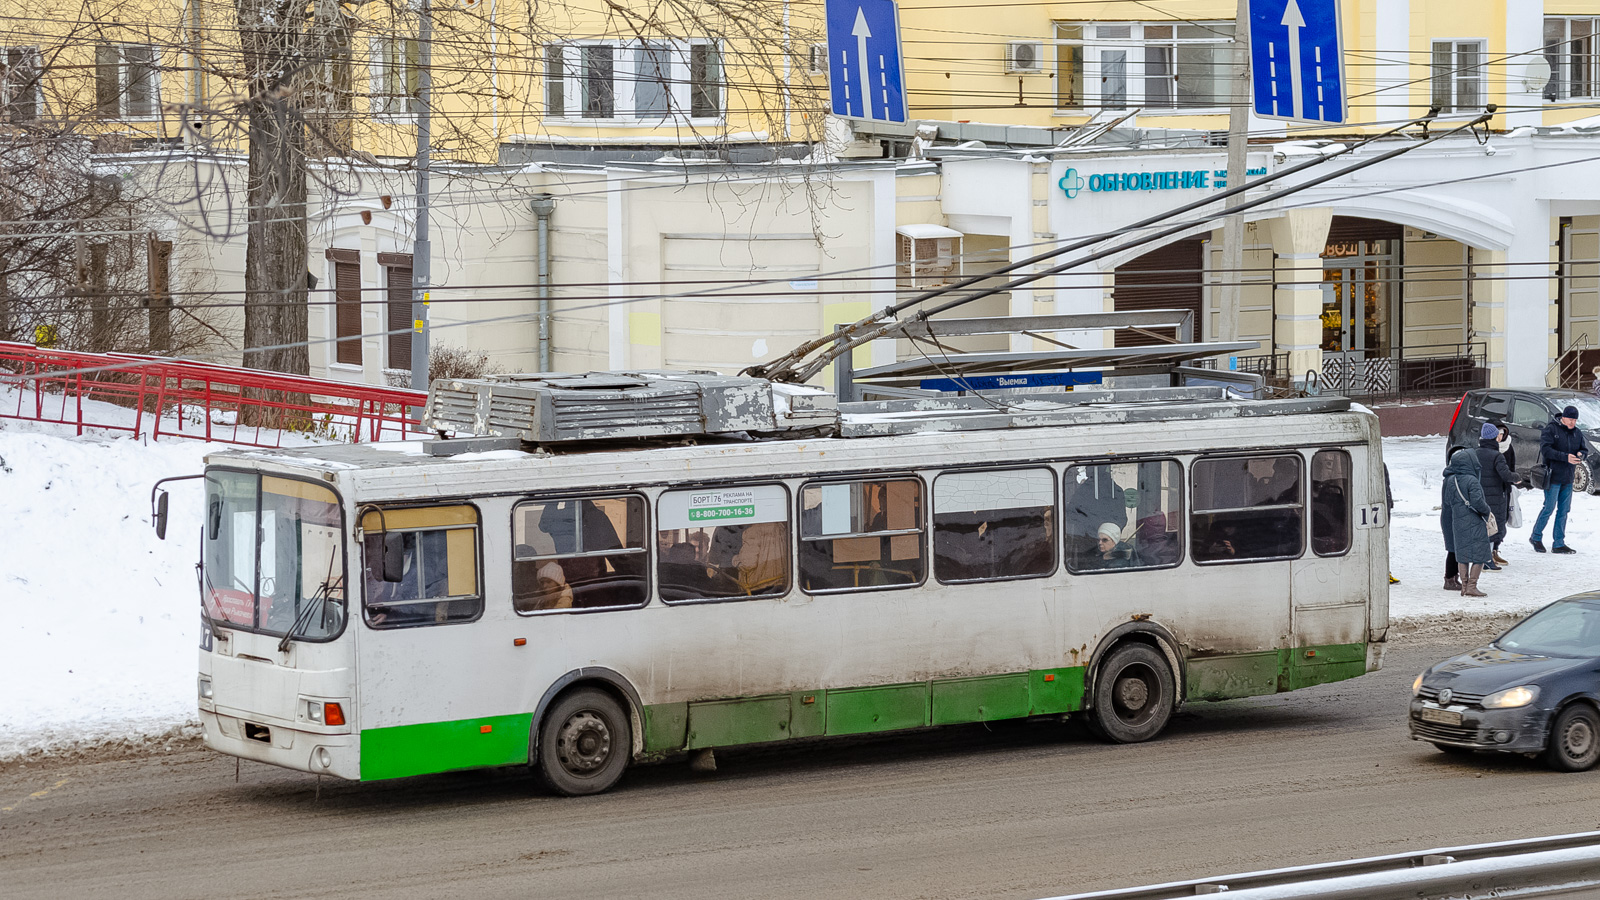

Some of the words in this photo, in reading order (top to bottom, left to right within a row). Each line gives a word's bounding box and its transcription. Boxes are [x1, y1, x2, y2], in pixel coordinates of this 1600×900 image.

[1089, 171, 1209, 192] ОБНОВЛЕНИЕ
[998, 377, 1028, 386] Выемка
[693, 496, 710, 504] БОРТ
[713, 495, 722, 503] 76
[695, 507, 753, 518] 8-800-700-16-36
[1361, 506, 1380, 525] 17
